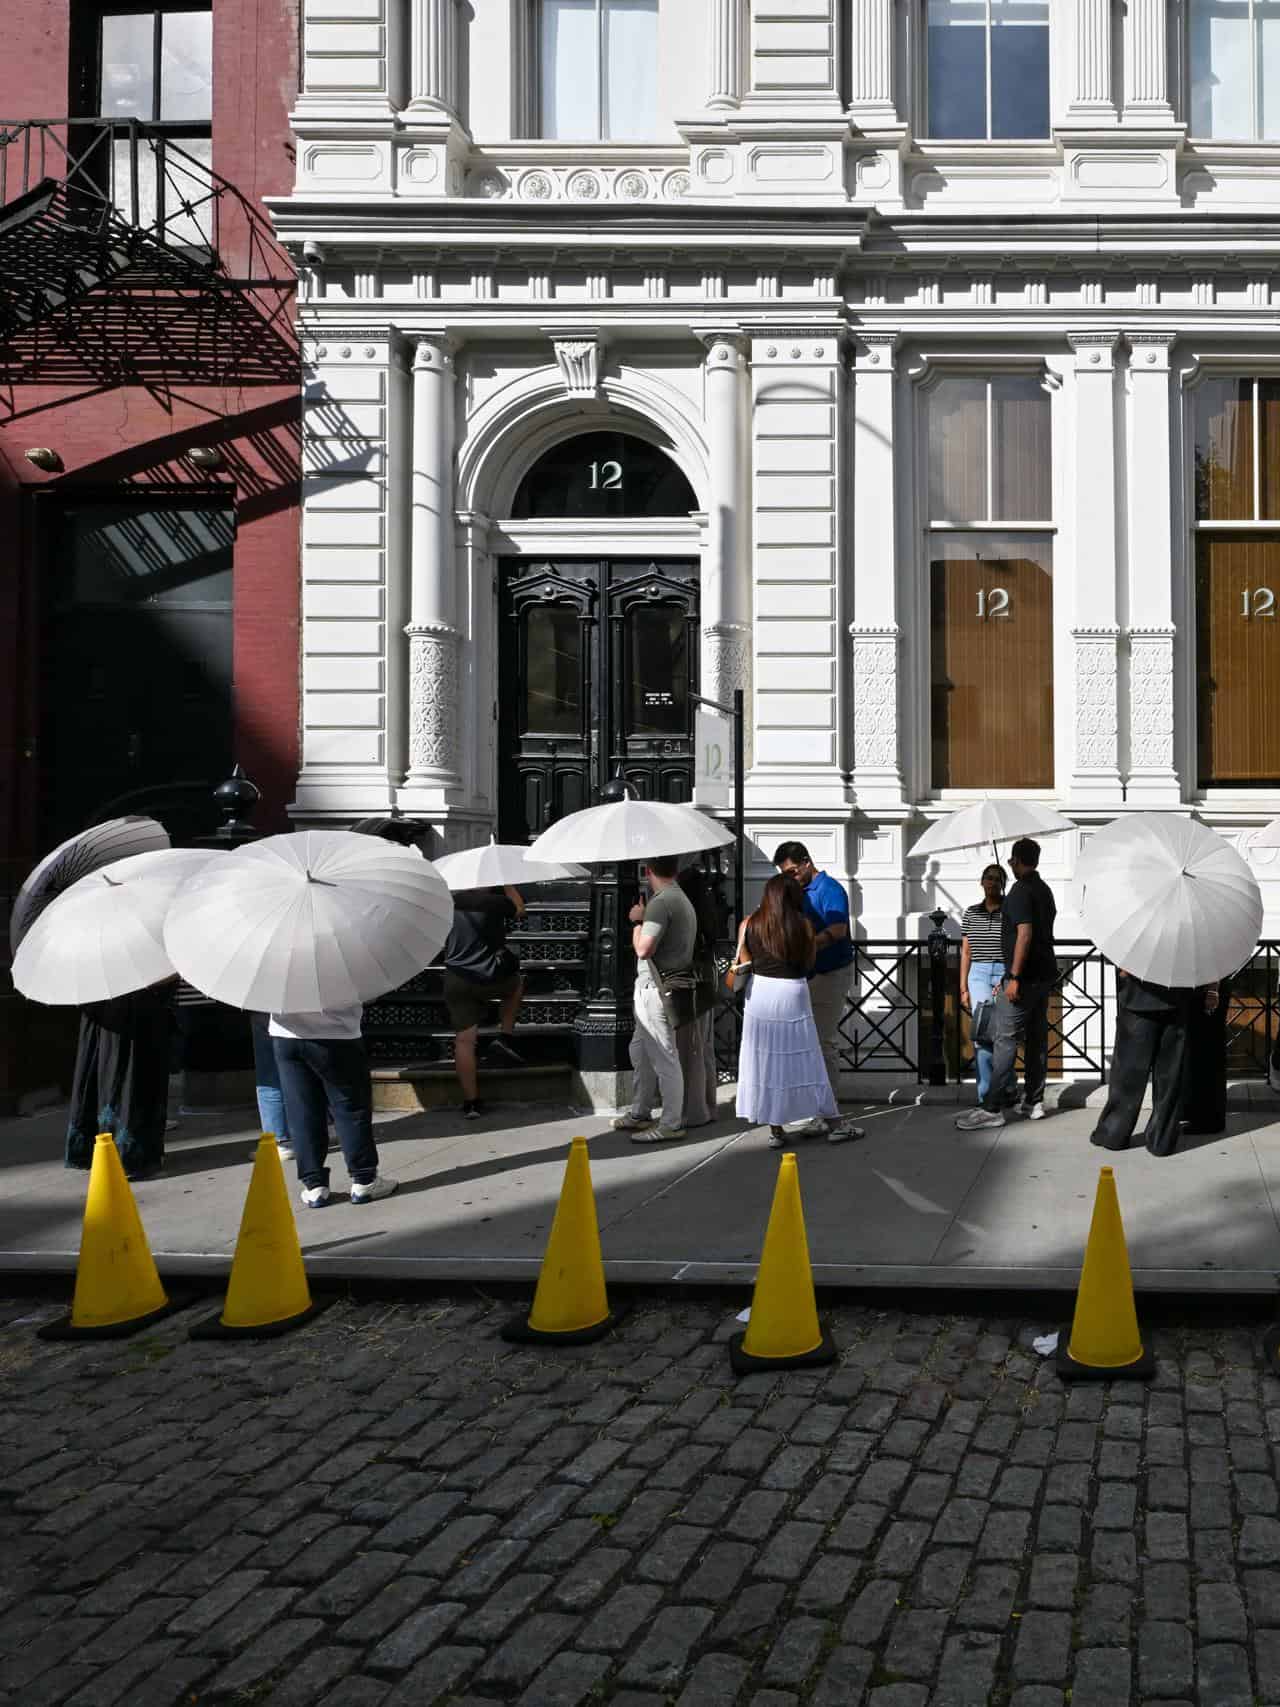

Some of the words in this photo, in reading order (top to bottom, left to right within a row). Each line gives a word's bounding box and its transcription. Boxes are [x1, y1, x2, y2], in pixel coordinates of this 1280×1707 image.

[589, 460, 623, 490] 12
[975, 587, 1010, 617] 12
[1240, 587, 1275, 617] 12
[704, 743, 725, 780] 12
